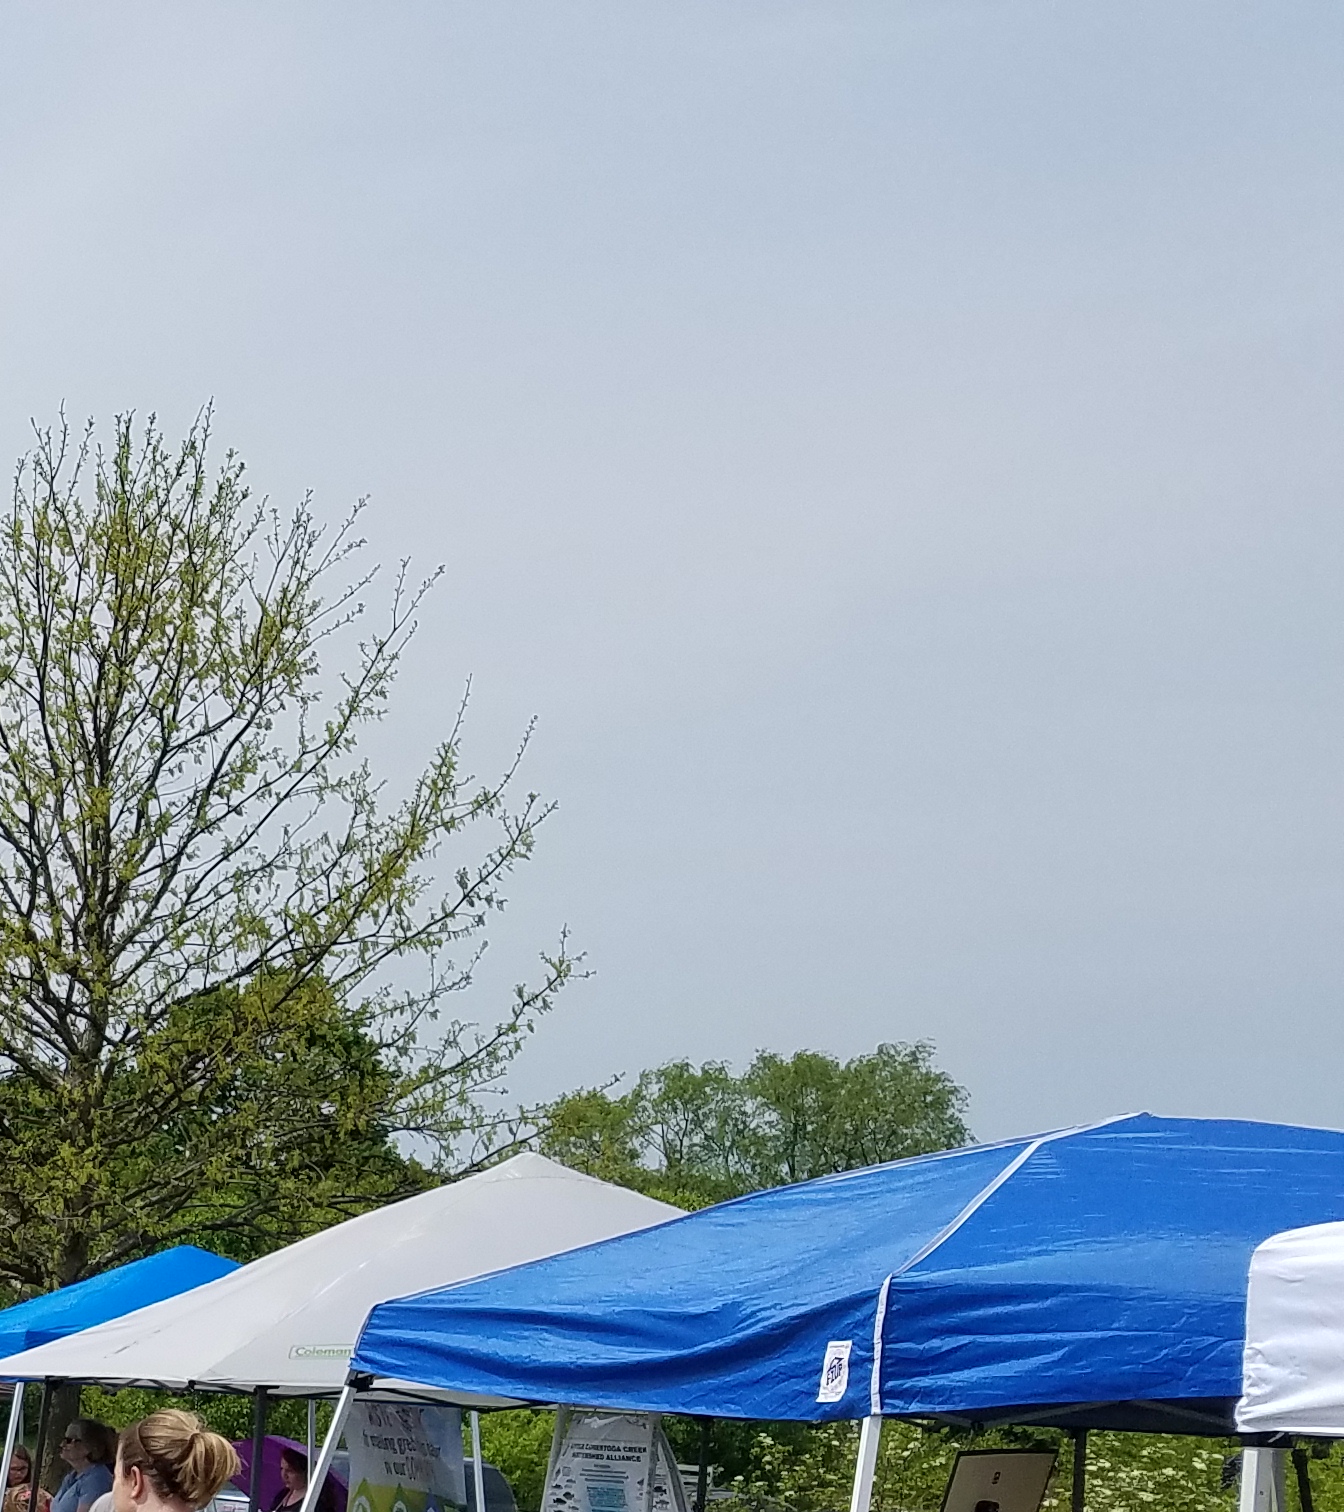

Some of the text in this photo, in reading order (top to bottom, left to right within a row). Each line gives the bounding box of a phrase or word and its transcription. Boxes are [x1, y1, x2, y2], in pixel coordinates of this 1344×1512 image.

[295, 1347, 352, 1357] Coleman
[623, 1446, 648, 1454] CREEK
[605, 1454, 642, 1463] ALLIANCE
